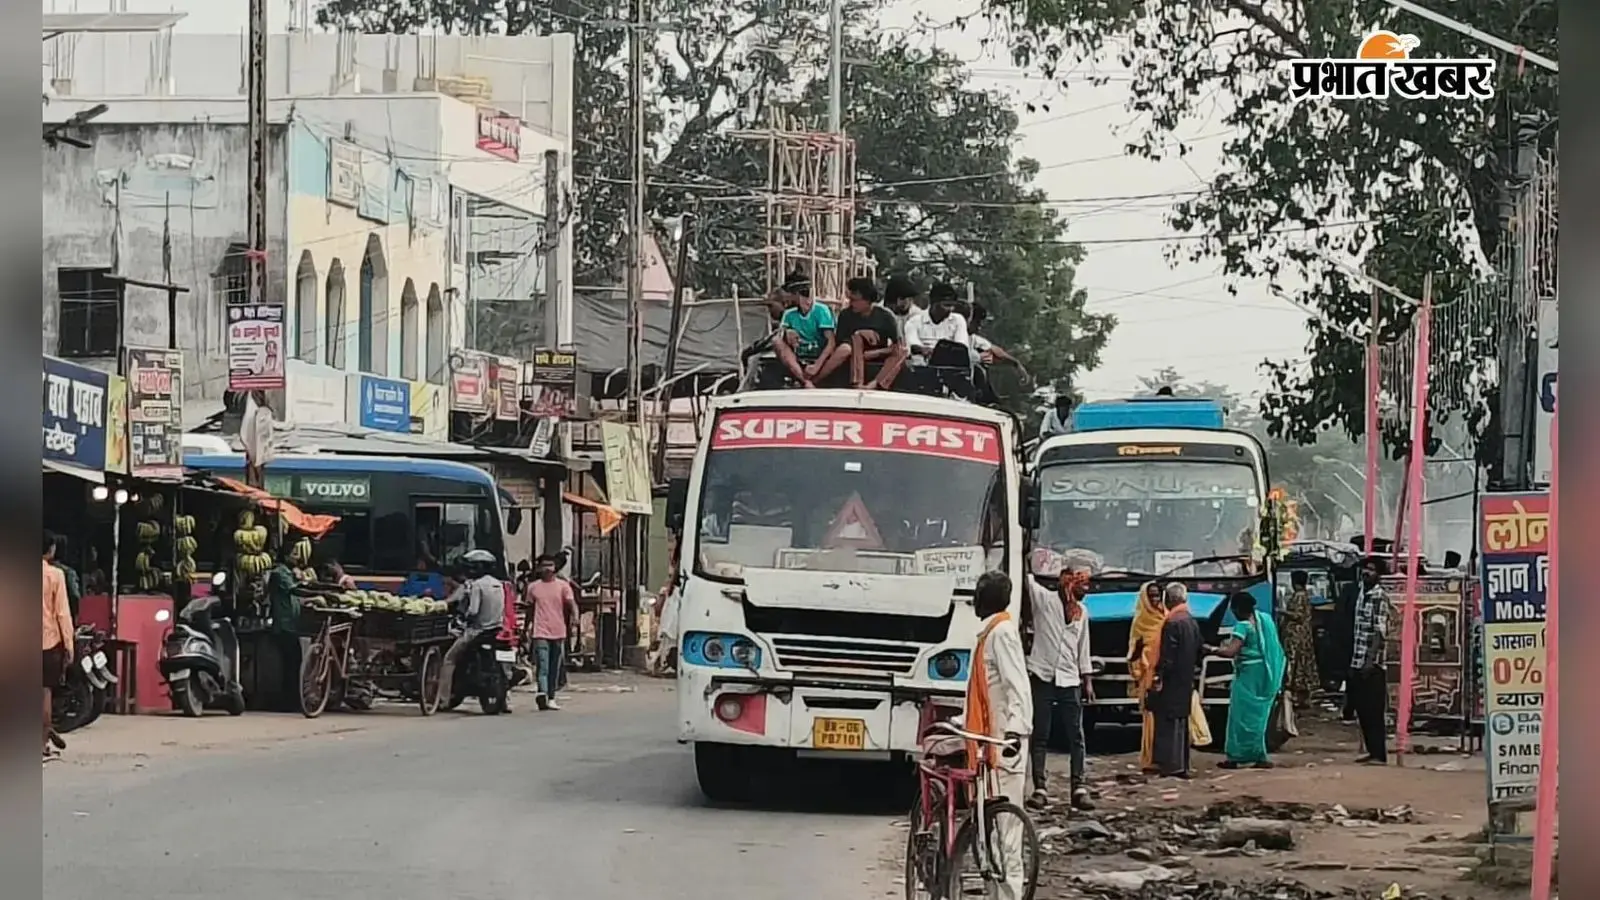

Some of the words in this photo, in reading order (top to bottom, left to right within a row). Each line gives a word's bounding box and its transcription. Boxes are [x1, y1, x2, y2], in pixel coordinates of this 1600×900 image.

[718, 418, 864, 444] SUPER
[881, 422, 994, 452] FAST
[303, 481, 366, 497] VOLVO
[1487, 563, 1529, 599] ज्ञान
[1492, 634, 1537, 651] आसान
[1493, 656, 1543, 685] 0%
